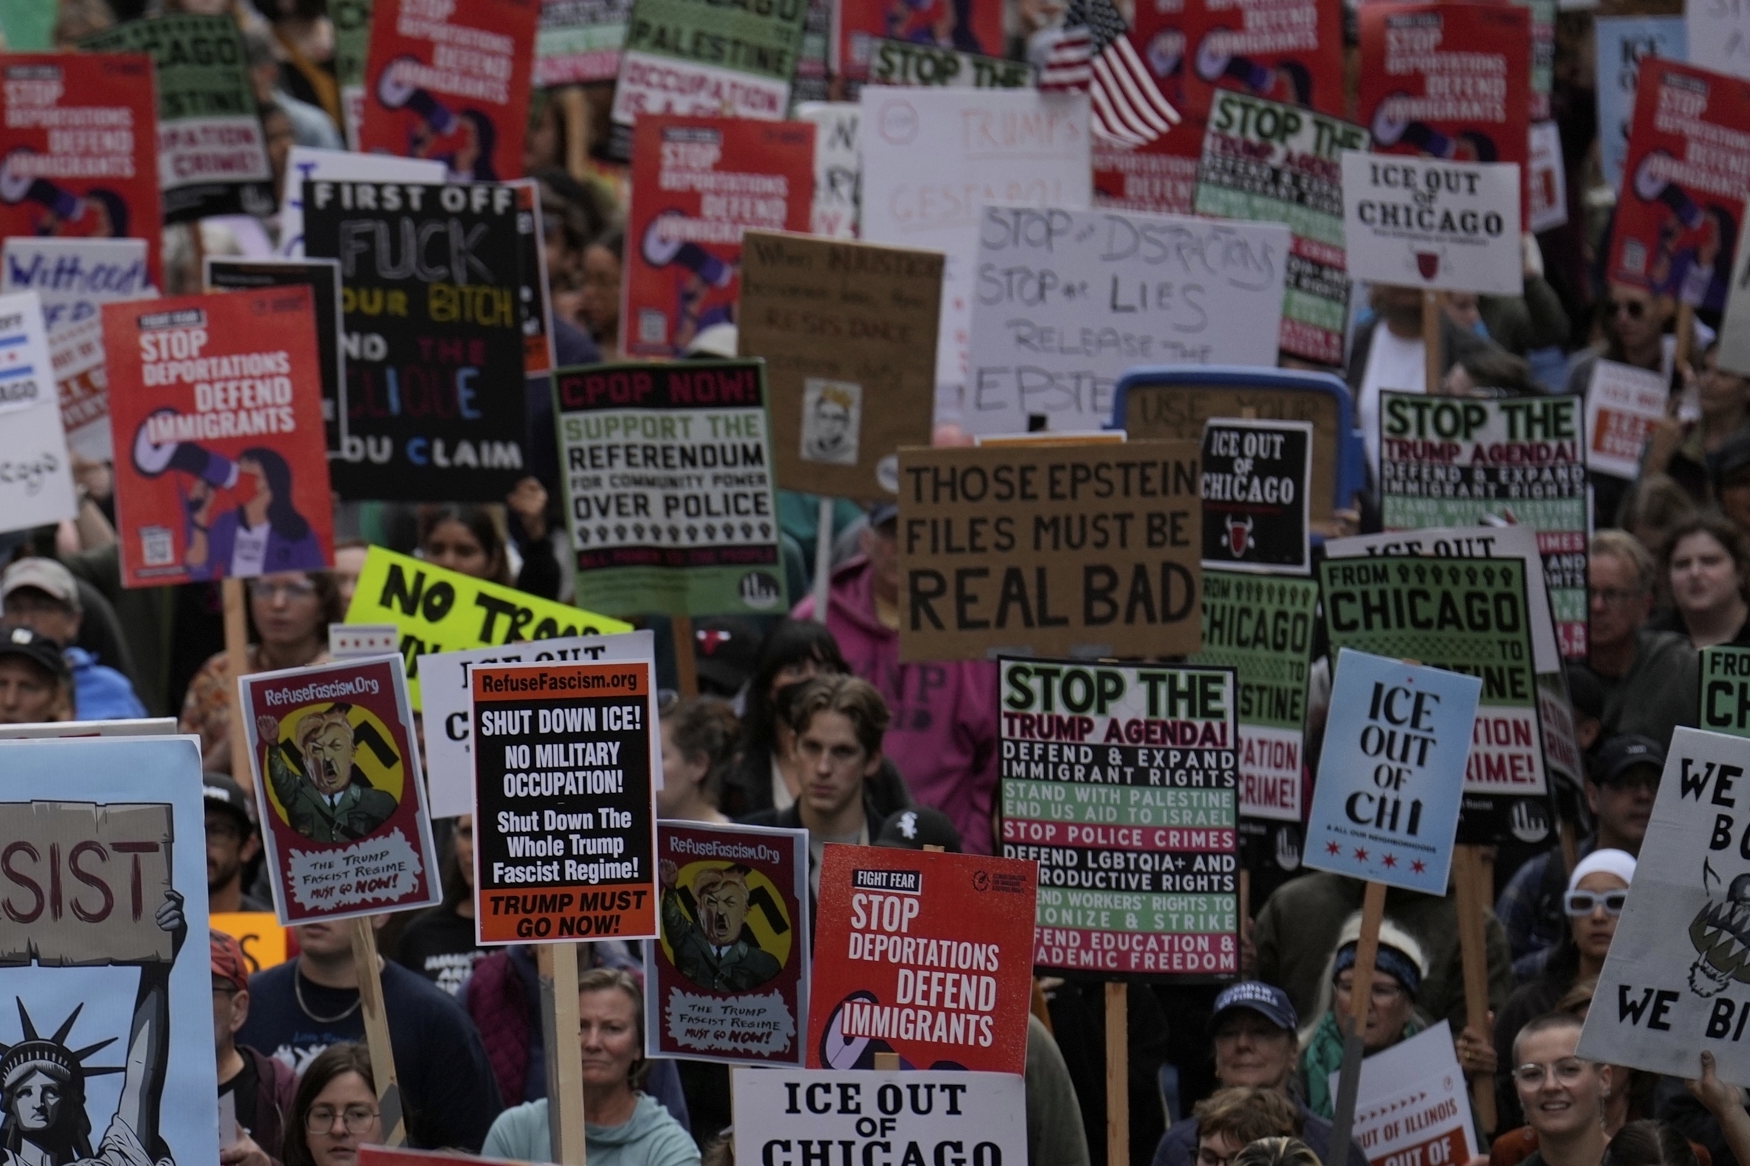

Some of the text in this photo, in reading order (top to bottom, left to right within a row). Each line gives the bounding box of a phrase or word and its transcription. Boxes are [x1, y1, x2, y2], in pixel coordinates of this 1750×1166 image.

[1370, 163, 1481, 195] ICE OUT
[1359, 200, 1504, 236] CHICAGO
[906, 458, 1198, 503] THOSE EPSTEIN
[906, 511, 1190, 555] FILES MUST BE
[909, 561, 1196, 631] REAL BAD
[265, 677, 379, 706] RefuseFascism.Org
[482, 671, 637, 693] RefuseFascism.org
[481, 706, 641, 736] SHUT DOWN ICE!
[1368, 682, 1440, 733] ICE
[505, 741, 620, 769] NO MILITARY
[1360, 724, 1436, 767] OUT
[503, 770, 623, 798] OCCUPATION!
[1374, 763, 1412, 791] OF
[497, 807, 632, 833] Shut Down The
[1345, 791, 1423, 836] CHI
[506, 834, 624, 858] Whole Trump
[302, 861, 407, 885] FASCIST REGIME
[310, 851, 389, 871] THE TRUMP
[493, 857, 639, 884] Fascist Regime!
[310, 874, 399, 899] MUST GO NOW!
[490, 890, 647, 915] TRUMP MUST
[517, 915, 621, 938] GO NOW!
[784, 1083, 966, 1115] ICE OUT
[855, 1117, 896, 1138] OF
